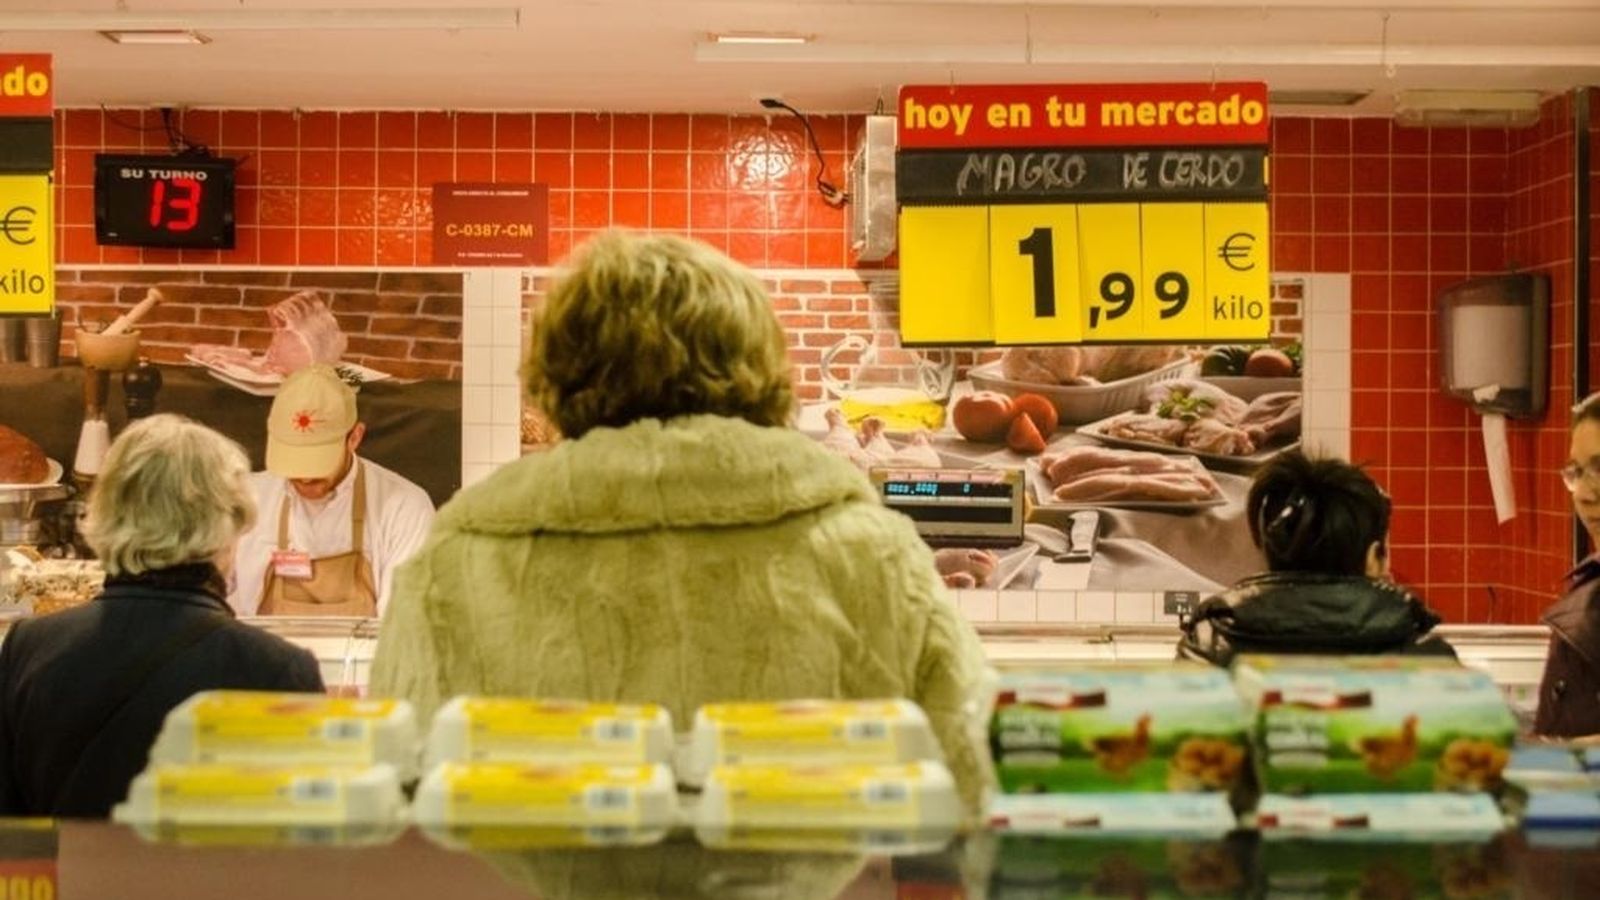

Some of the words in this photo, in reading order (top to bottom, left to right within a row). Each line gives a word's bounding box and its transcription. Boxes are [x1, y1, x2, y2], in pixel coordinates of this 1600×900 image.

[905, 96, 972, 135] hoy
[987, 102, 1031, 128] en
[1046, 96, 1086, 127] tu
[1101, 93, 1264, 127] mercado
[120, 168, 143, 179] SU
[148, 169, 208, 181] TURNO
[956, 153, 1086, 195] MAGRO
[1122, 153, 1150, 189] DE
[1158, 152, 1245, 188] CERDO
[150, 178, 202, 231] 13
[446, 223, 533, 237] C-0387-CM
[1218, 232, 1256, 272] €
[1213, 295, 1264, 320] kilo
